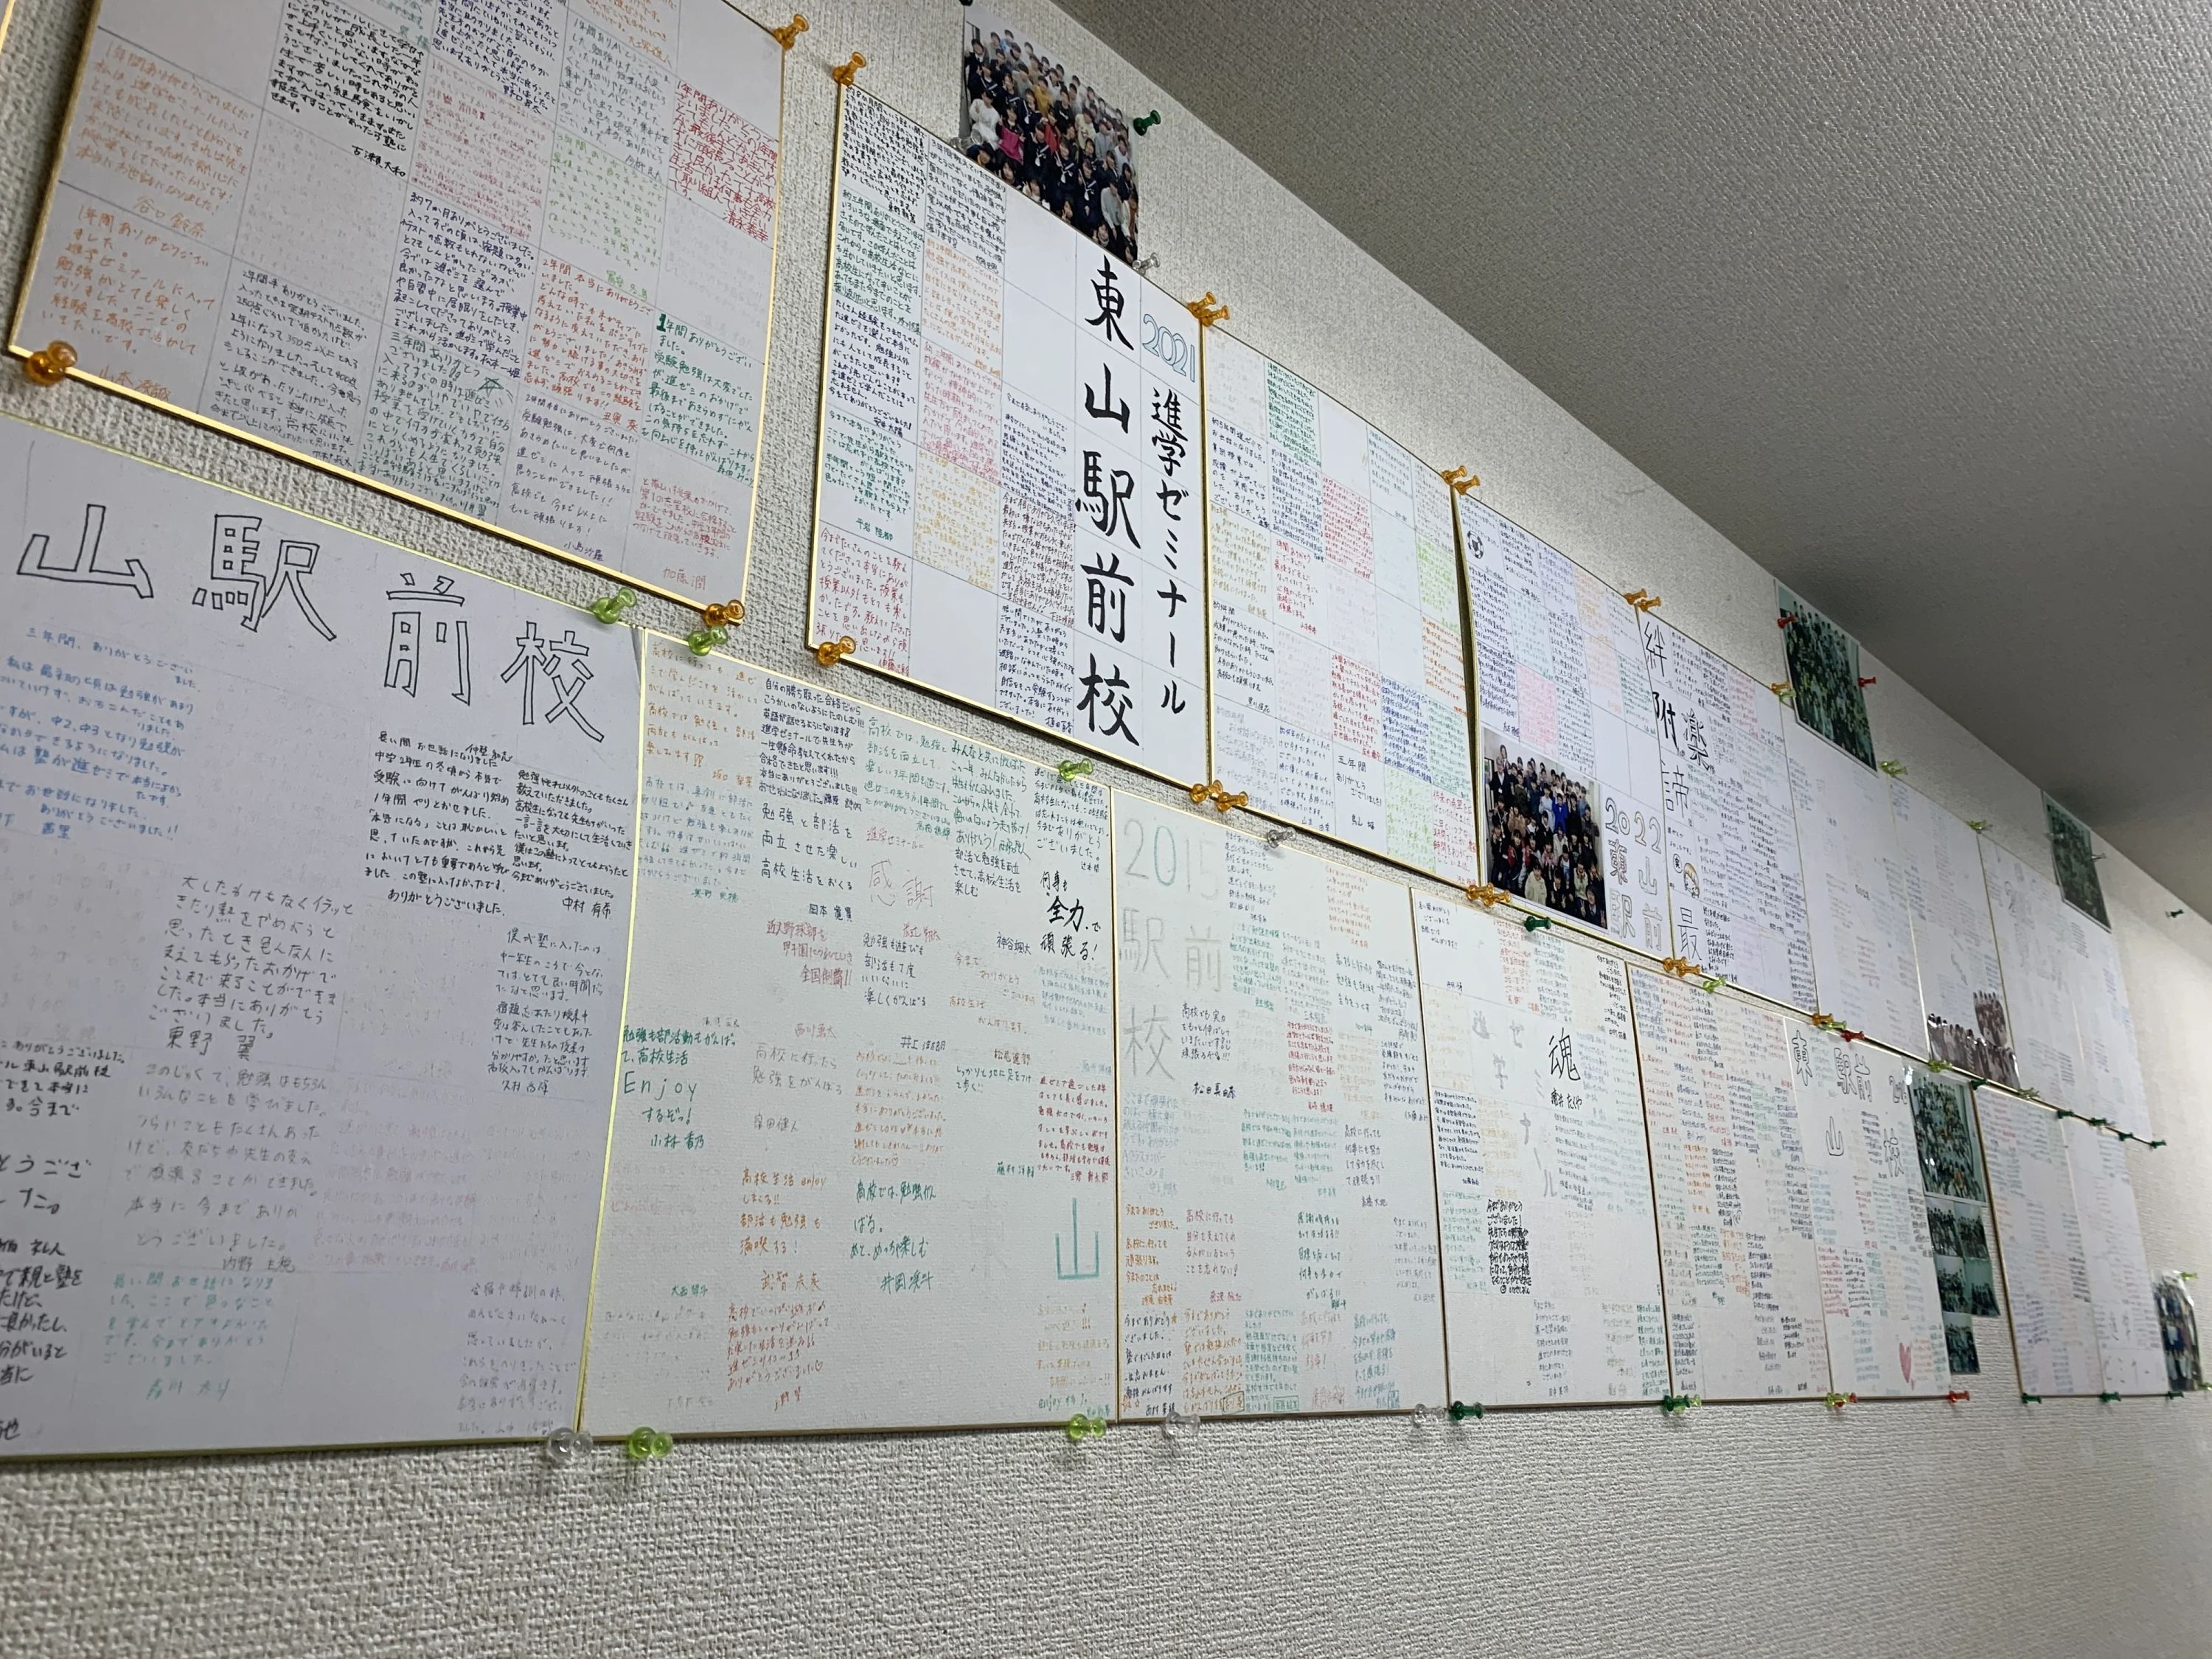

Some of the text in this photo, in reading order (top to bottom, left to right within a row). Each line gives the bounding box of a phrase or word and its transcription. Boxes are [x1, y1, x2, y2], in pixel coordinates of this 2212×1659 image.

[1142, 313, 1194, 383] 2021
[1075, 254, 1141, 747] 東山駅前校
[1152, 386, 1189, 714] 進学ゼミナール
[761, 802, 852, 839] 勉強と部活を
[761, 831, 858, 868] 両立させた楽しい
[563, 896, 585, 913] 中村
[869, 859, 933, 909] 感謝
[955, 880, 978, 897] 楽しむ
[624, 1071, 697, 1102] Enjoy
[1055, 1197, 1099, 1279] 山
